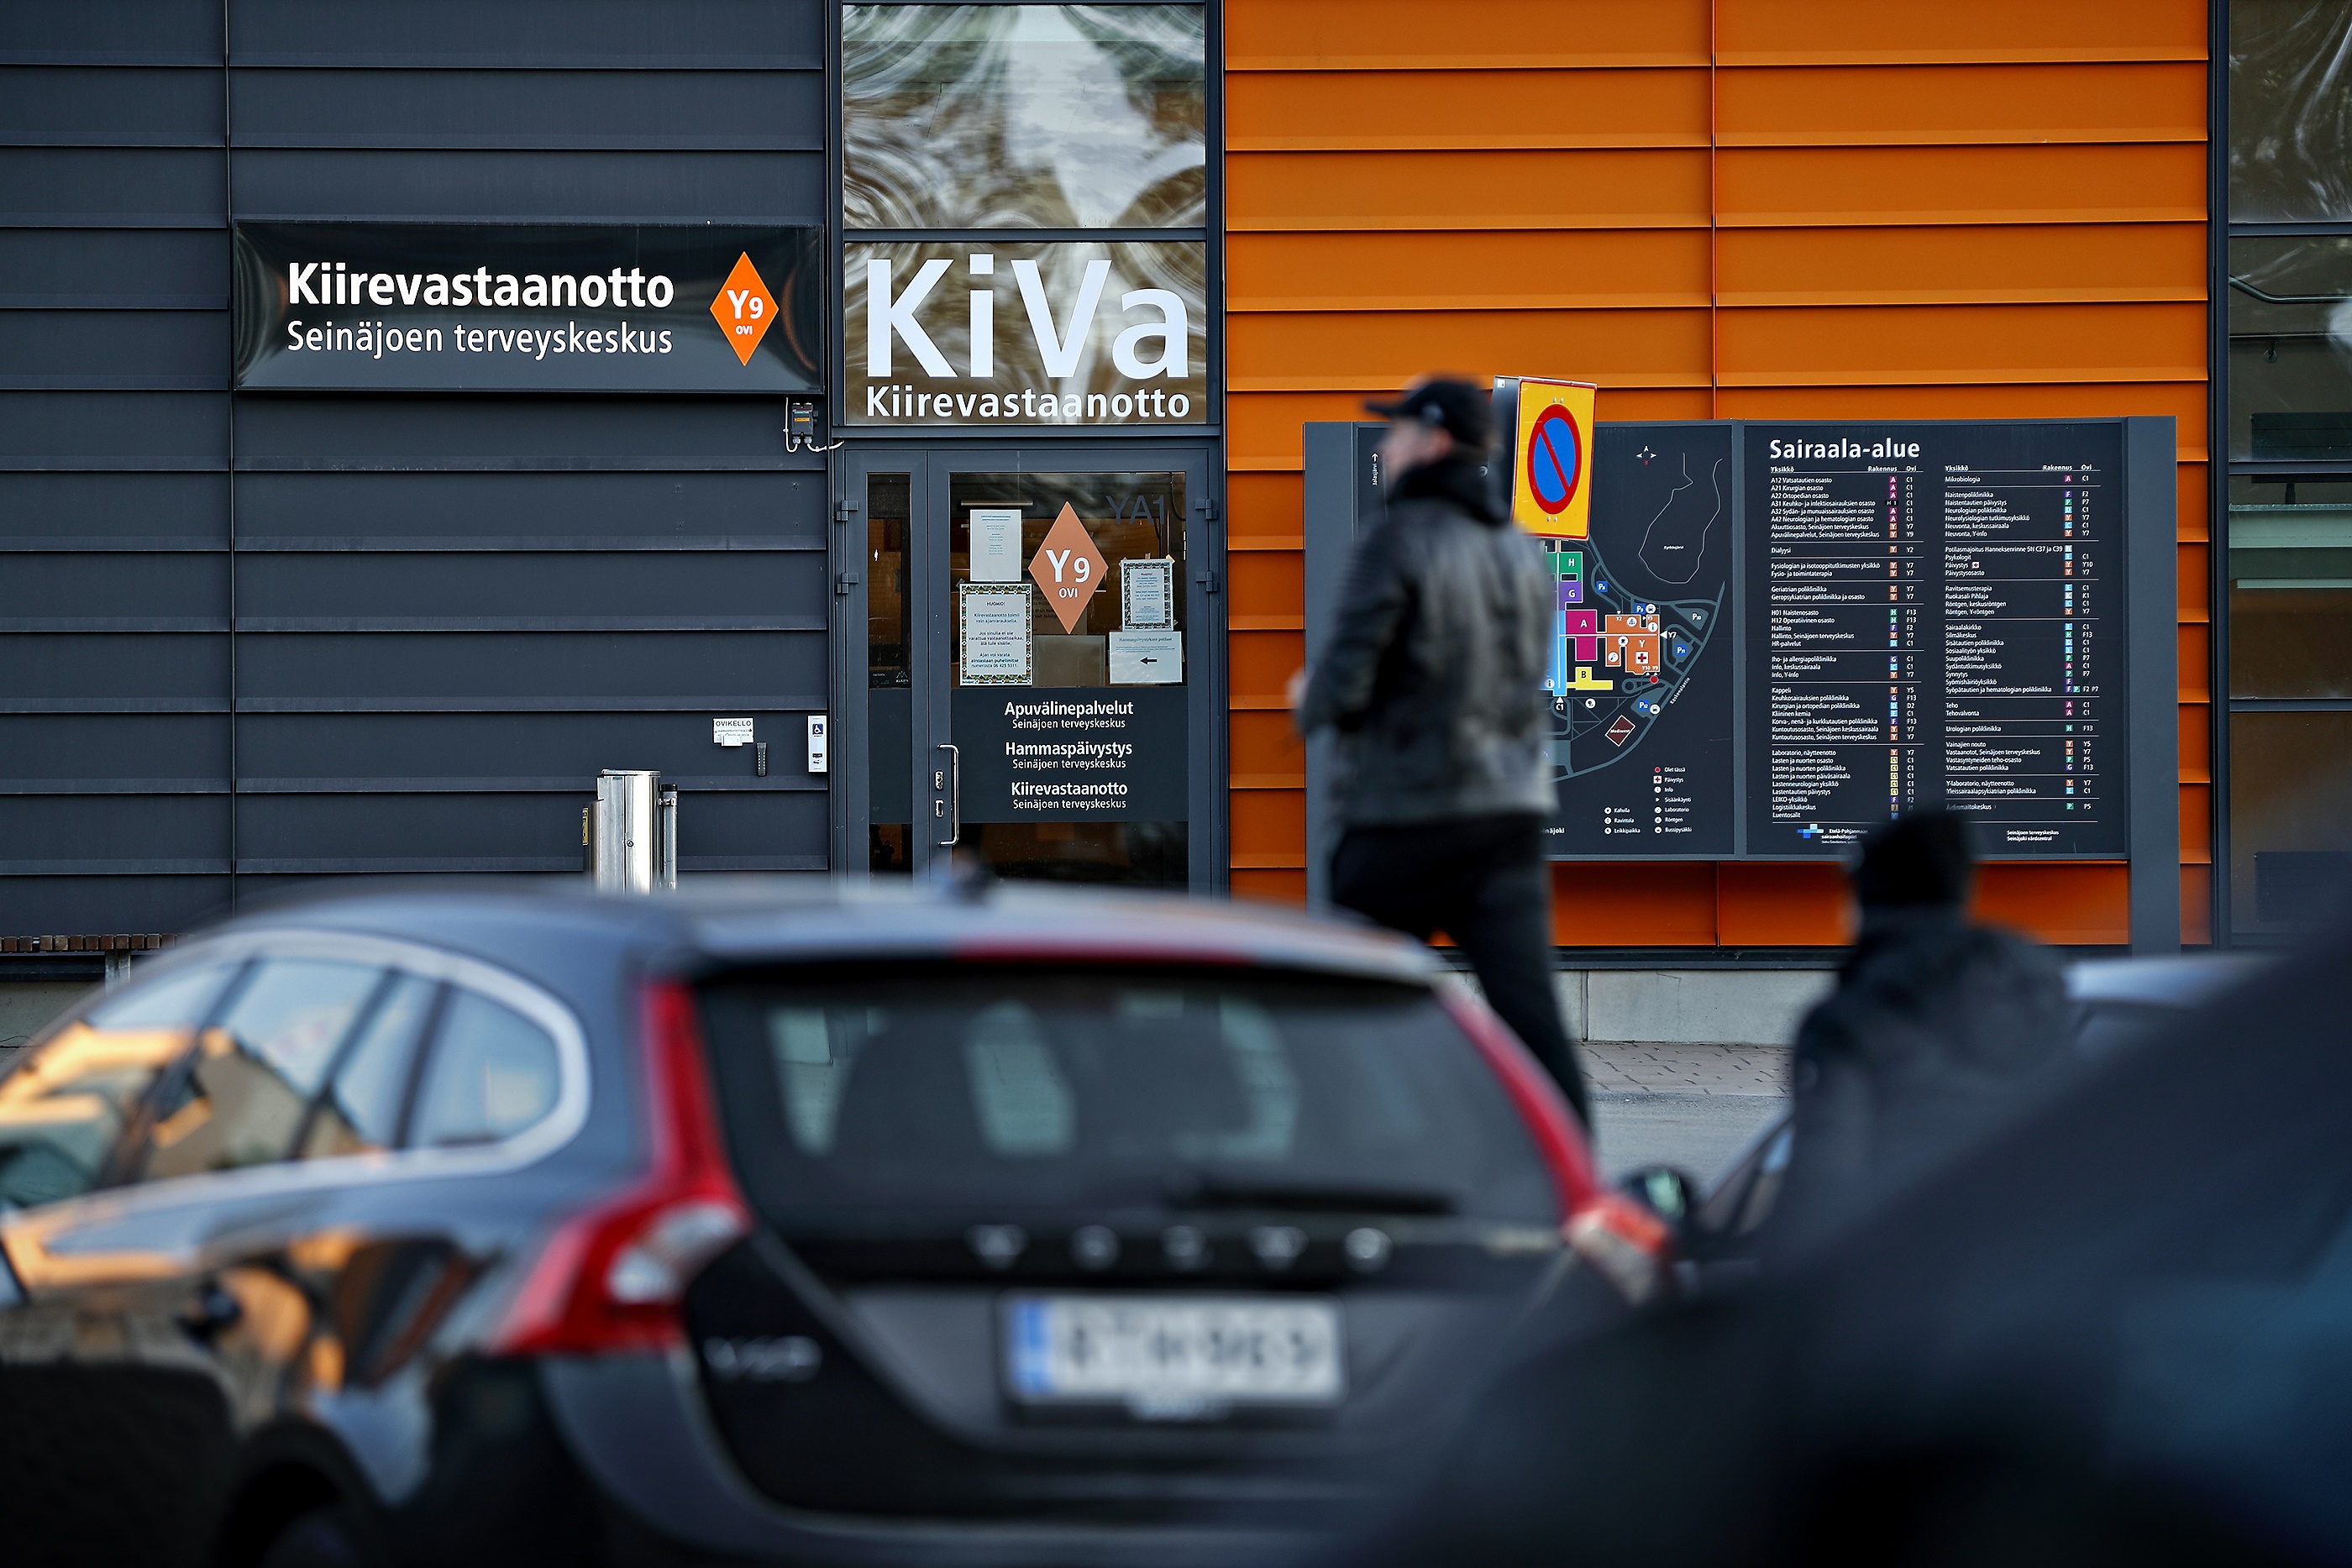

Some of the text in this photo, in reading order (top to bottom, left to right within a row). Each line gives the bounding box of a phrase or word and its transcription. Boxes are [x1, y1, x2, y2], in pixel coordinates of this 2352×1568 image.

[290, 262, 674, 307] Kiirevastaanotto
[727, 290, 764, 319] Y9
[867, 253, 1189, 379] KiVa
[288, 321, 672, 360] Seinäjoen terveyskeskus
[736, 326, 753, 335] OVI
[867, 385, 1190, 418] Kiirevastaanotto
[1770, 437, 1920, 459] Sairaala-alue
[1106, 495, 1164, 524] YA1
[1045, 549, 1091, 584] Y9
[1058, 588, 1078, 599] OVI
[1004, 700, 1134, 719] Apuvälinepalvelut
[1012, 718, 1126, 731] Seinäjoen terveyskeskus
[1006, 741, 1133, 758] Hammaspäivystys
[1013, 758, 1126, 771] Seinäjoen terveyskeskus
[1011, 781, 1128, 796] Kiirevastaanotto
[1013, 798, 1126, 811] Seinäjoen terveyskeskus
